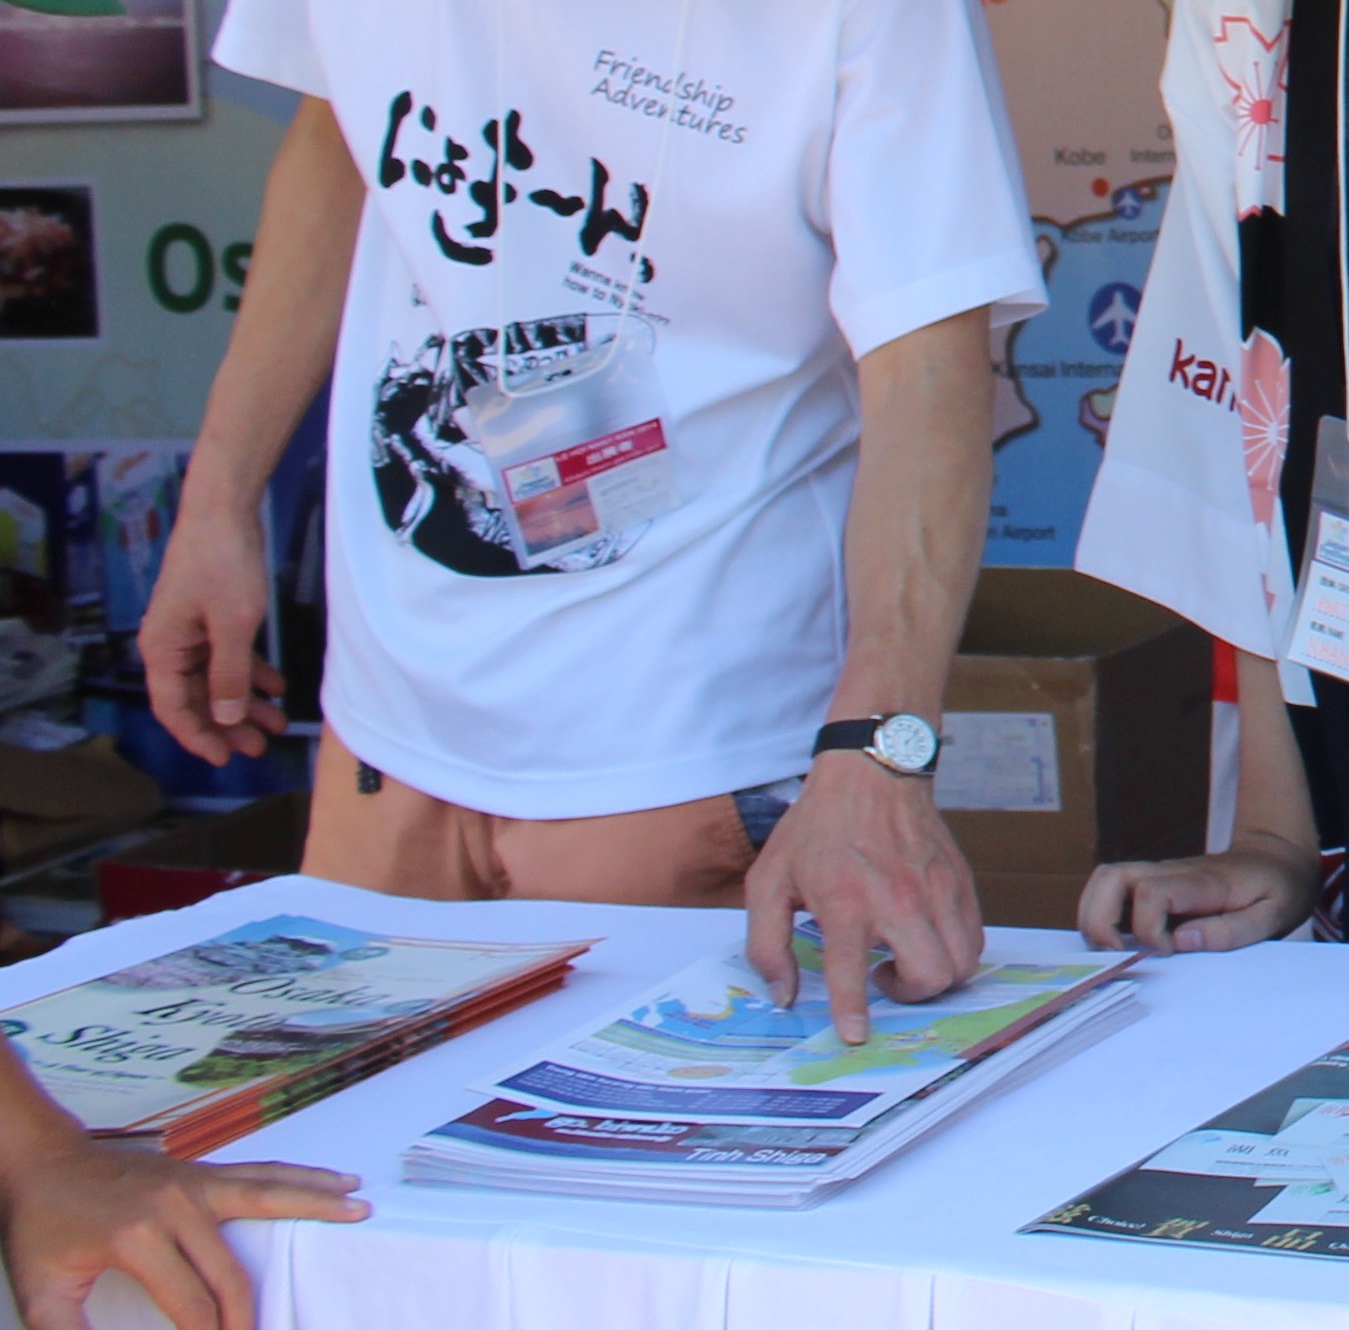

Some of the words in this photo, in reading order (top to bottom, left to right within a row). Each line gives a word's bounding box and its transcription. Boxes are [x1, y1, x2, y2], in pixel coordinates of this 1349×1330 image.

[594, 49, 735, 119] Friendship
[591, 78, 748, 144] Adventures
[1055, 147, 1106, 166] Kobe
[1169, 337, 1236, 412] kan
[230, 976, 393, 1008] Osaka
[133, 998, 287, 1030] Kyoto
[38, 1024, 197, 1064] Shiga
[746, 1148, 829, 1166] Shiga
